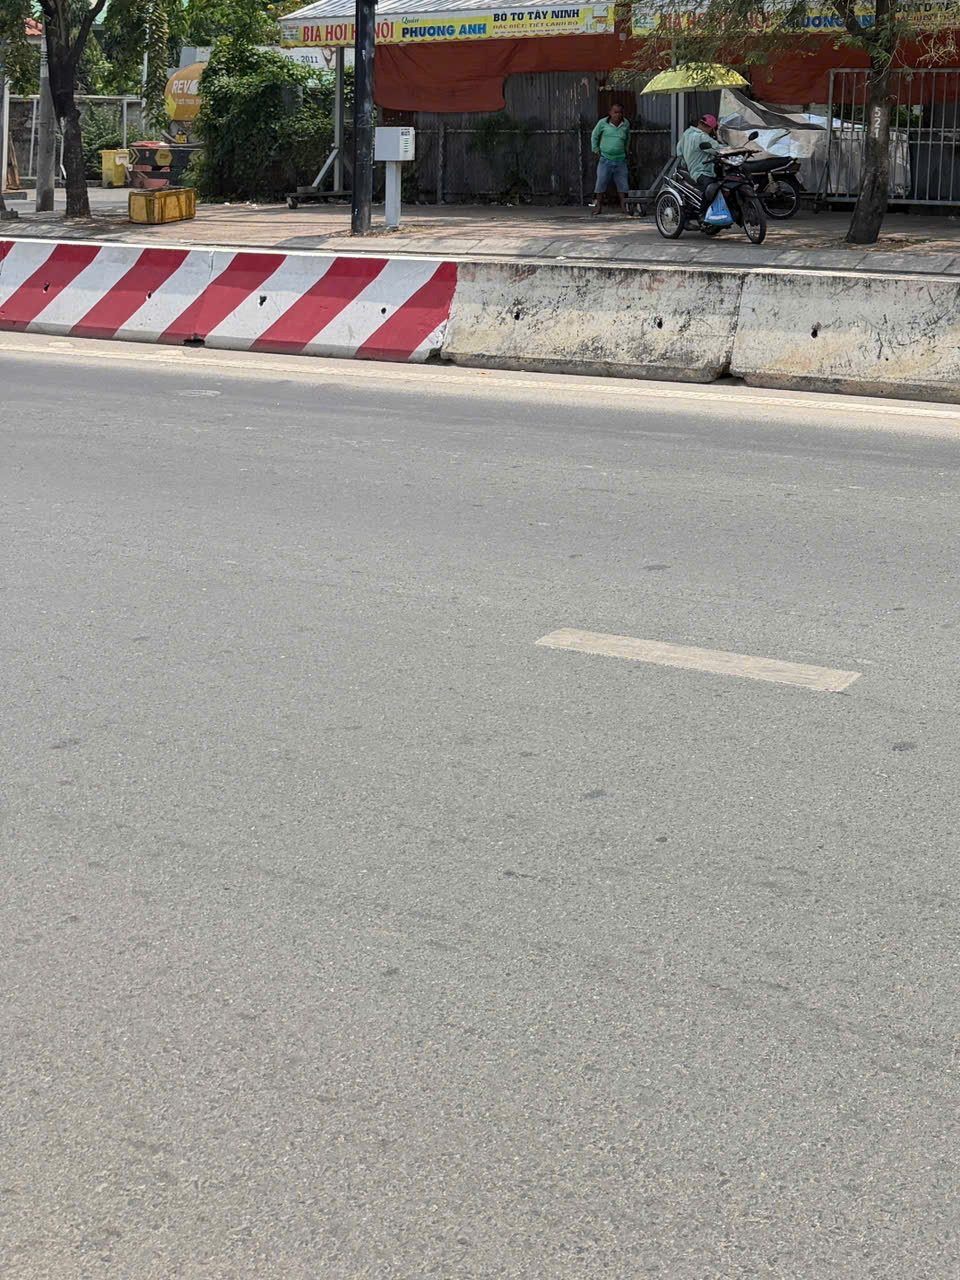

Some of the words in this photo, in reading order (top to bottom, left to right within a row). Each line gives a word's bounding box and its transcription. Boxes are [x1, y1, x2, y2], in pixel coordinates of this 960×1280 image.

[493, 10, 508, 22] BÒ
[528, 9, 549, 20] TÂY
[551, 8, 580, 19] NINH
[303, 25, 322, 42] BIA
[326, 22, 348, 41] HƠI
[459, 23, 487, 35] ANH
[301, 55, 319, 63] 2011
